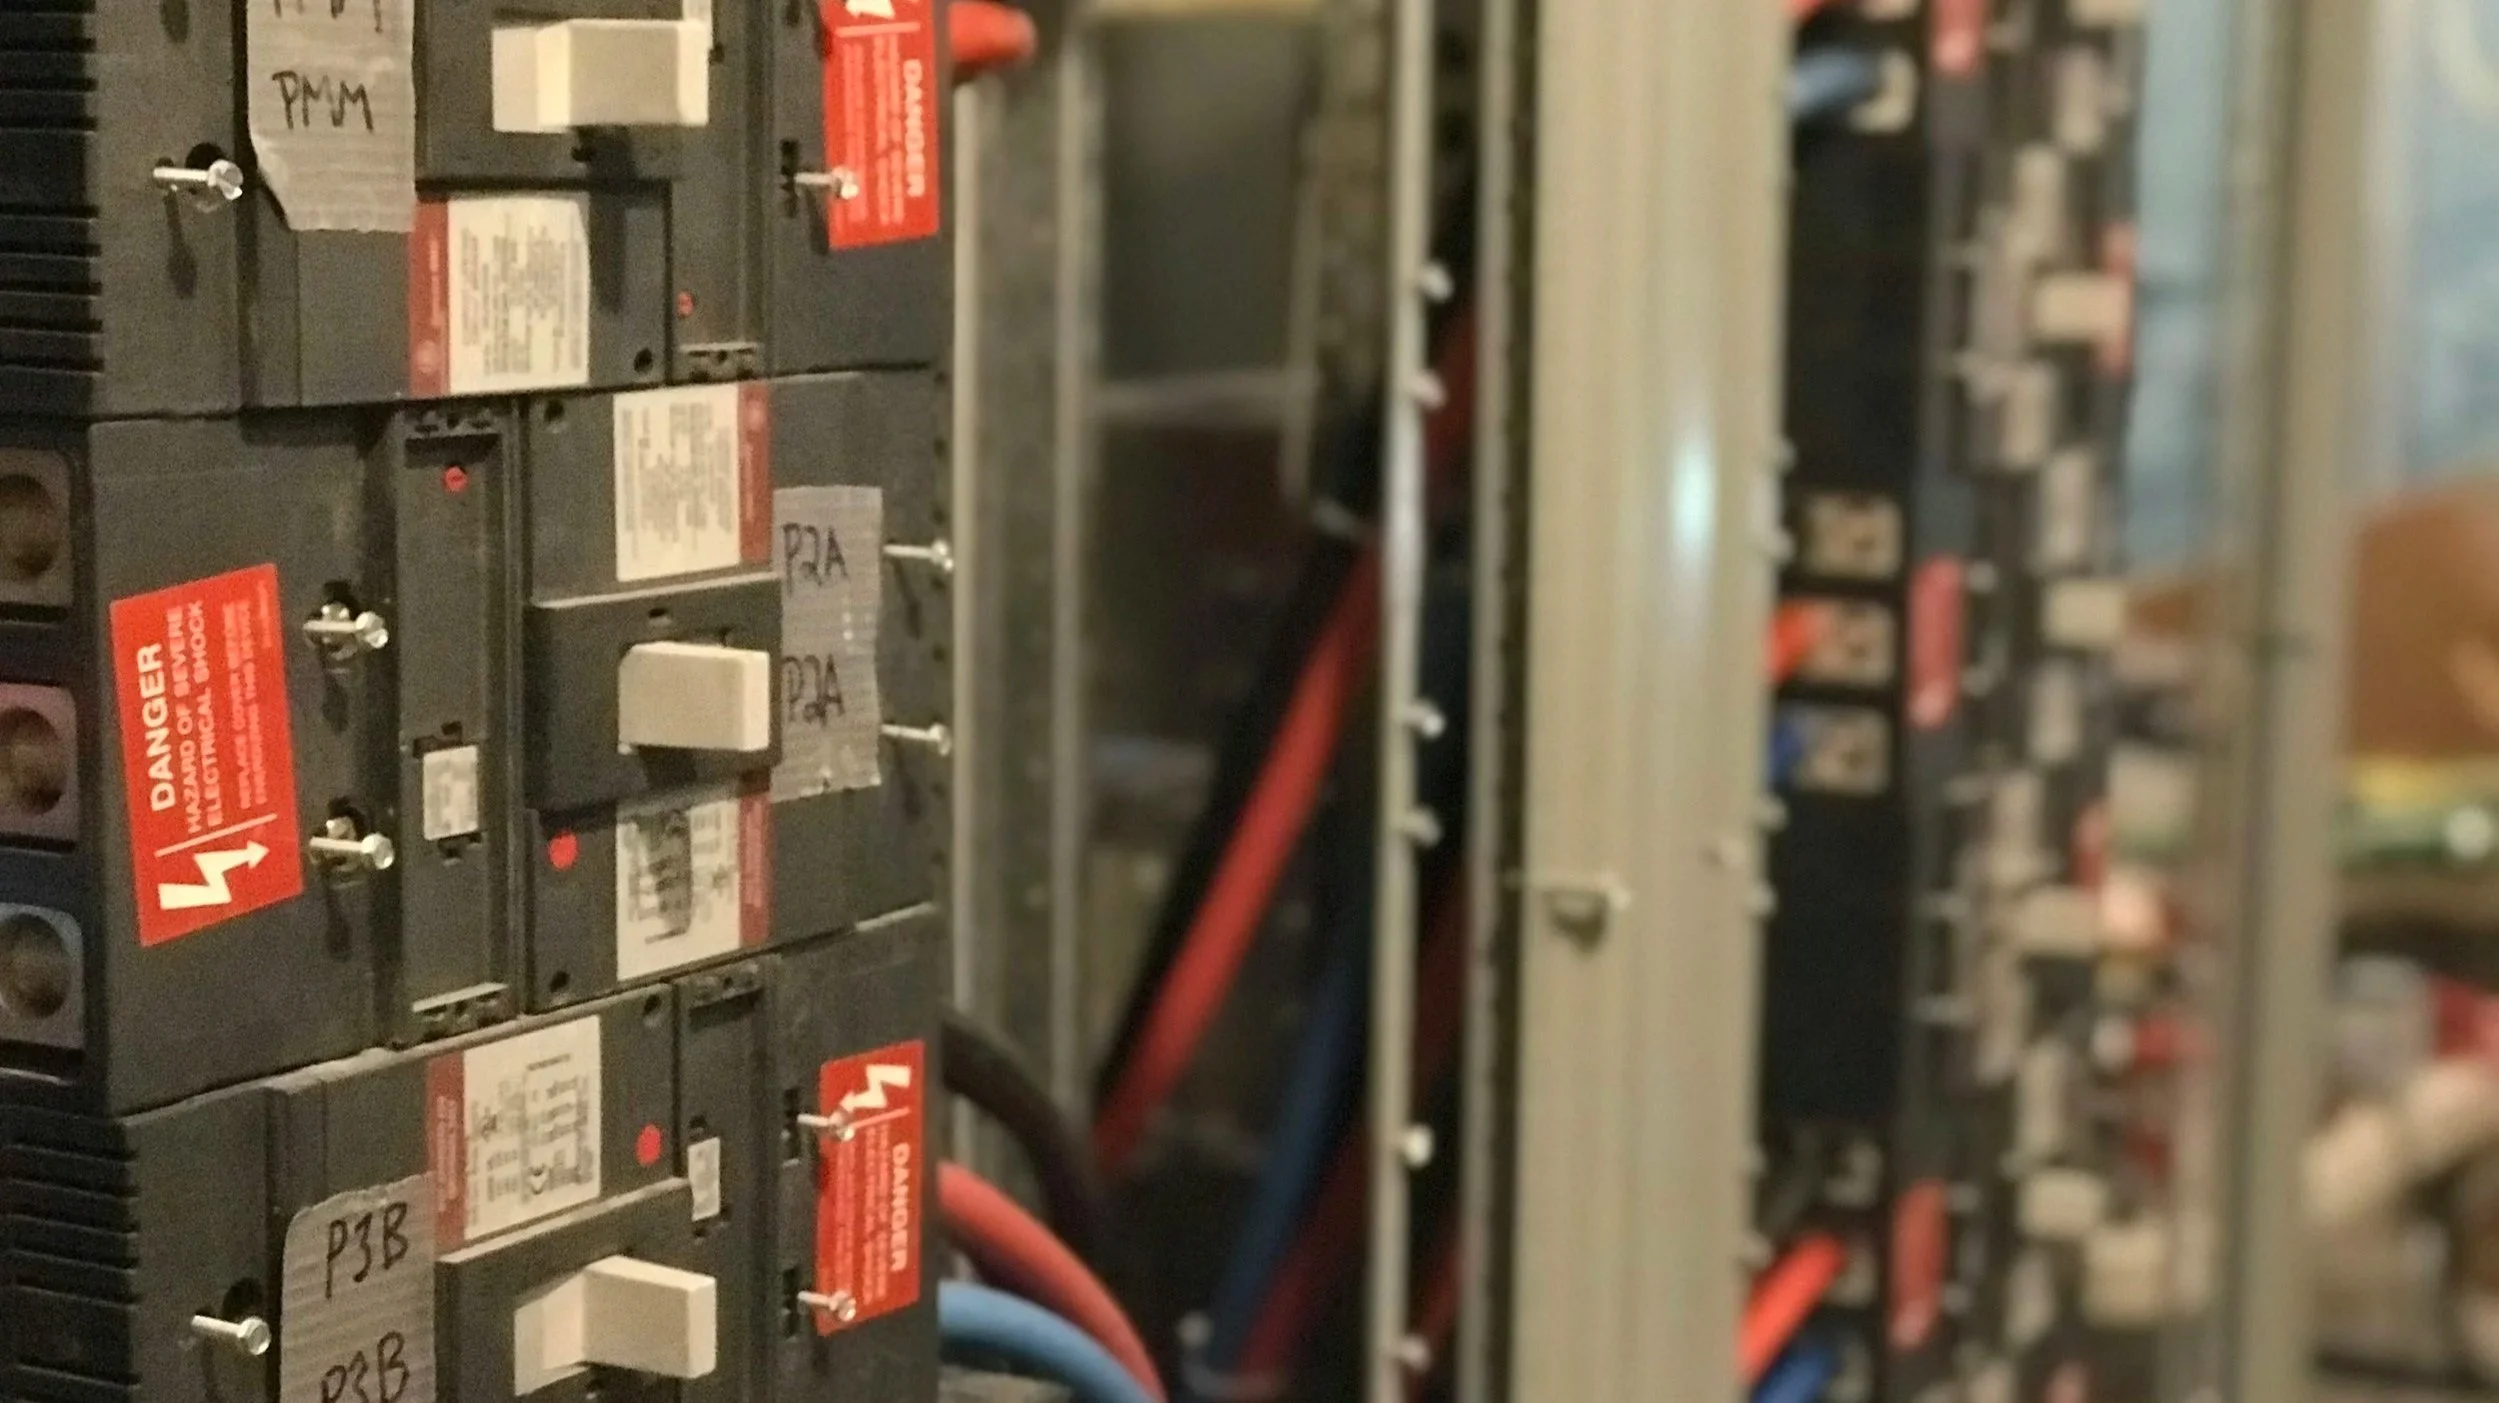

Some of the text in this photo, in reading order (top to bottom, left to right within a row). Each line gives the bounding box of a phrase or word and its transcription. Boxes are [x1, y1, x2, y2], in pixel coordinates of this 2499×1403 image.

[272, 70, 374, 135] PMM
[903, 59, 925, 197] DANGER
[782, 522, 850, 598] P2A
[137, 642, 177, 812] DANGER
[166, 605, 202, 835] HAZARD OF SEVERE
[187, 600, 223, 828] ELECTRICAL SHOCK
[782, 653, 846, 729] P2A
[326, 1202, 409, 1300] P3B
[891, 1143, 910, 1272] DANGER
